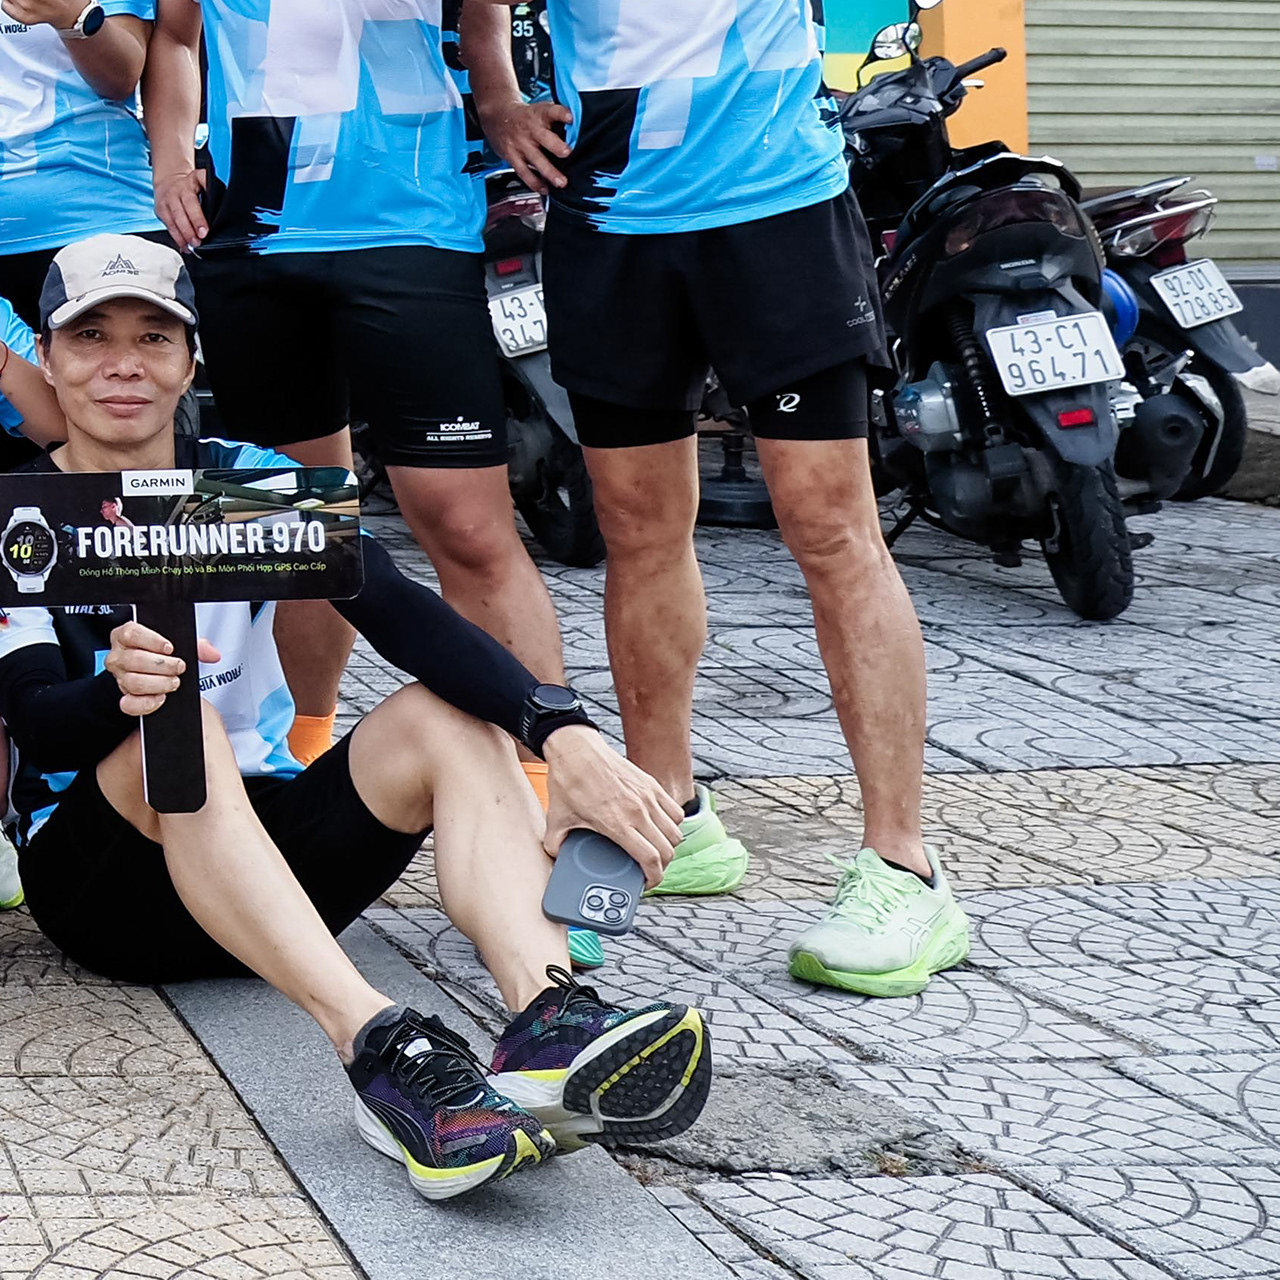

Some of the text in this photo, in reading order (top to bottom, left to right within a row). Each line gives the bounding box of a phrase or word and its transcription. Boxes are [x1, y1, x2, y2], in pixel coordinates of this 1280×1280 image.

[512, 21, 534, 37] 35
[1000, 259, 1036, 269] HONDA
[1173, 288, 1235, 324] 728.85
[1010, 321, 1088, 357] 43-C1
[1008, 349, 1110, 389] 964.71
[130, 476, 186, 489] GARMIN
[9, 543, 33, 559] 10
[78, 520, 326, 558] FORERUNNER 970
